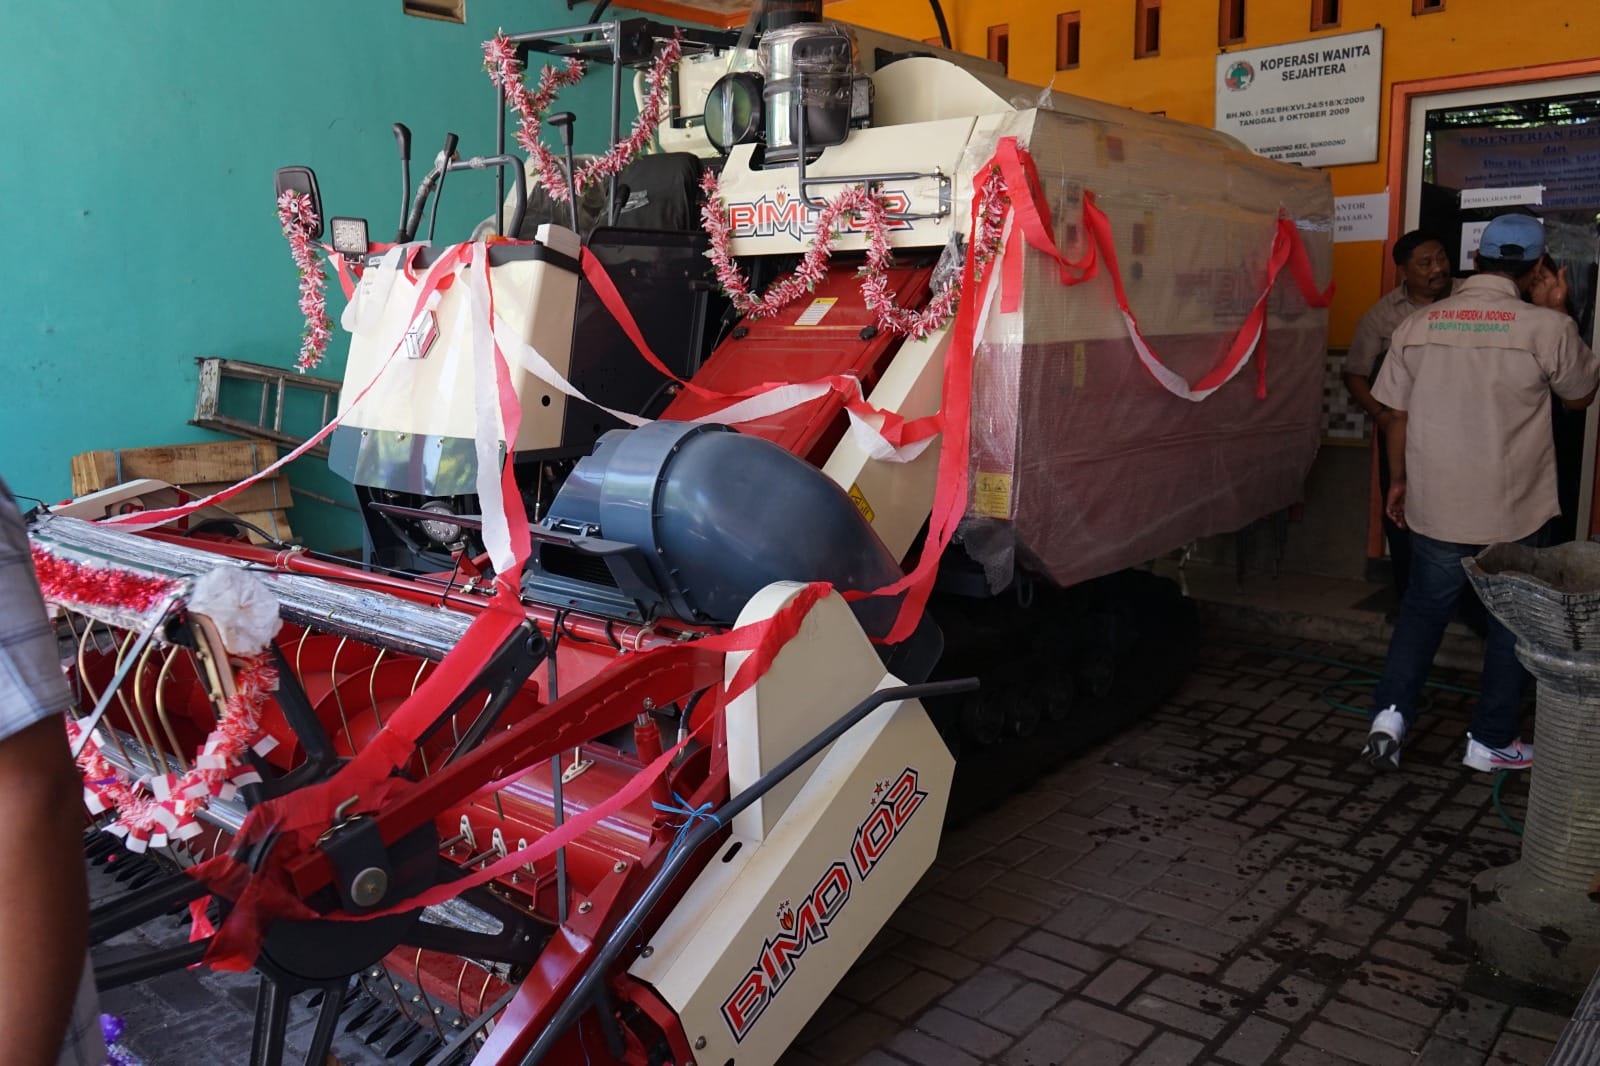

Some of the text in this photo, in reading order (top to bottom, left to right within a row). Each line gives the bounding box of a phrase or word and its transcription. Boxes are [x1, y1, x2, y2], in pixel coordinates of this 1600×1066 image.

[1259, 44, 1371, 72] KOPERASI WANITA
[1281, 63, 1347, 82] SEJAHTERA
[1239, 116, 1277, 127] TANGGAL
[1286, 110, 1328, 121] OKTOBER
[1329, 107, 1350, 116] 2009
[1335, 201, 1366, 211] ANTOR
[1485, 310, 1517, 321] INDONESIA
[1428, 322, 1472, 332] KABUPATEN
[720, 766, 929, 1044] BIMO 102
